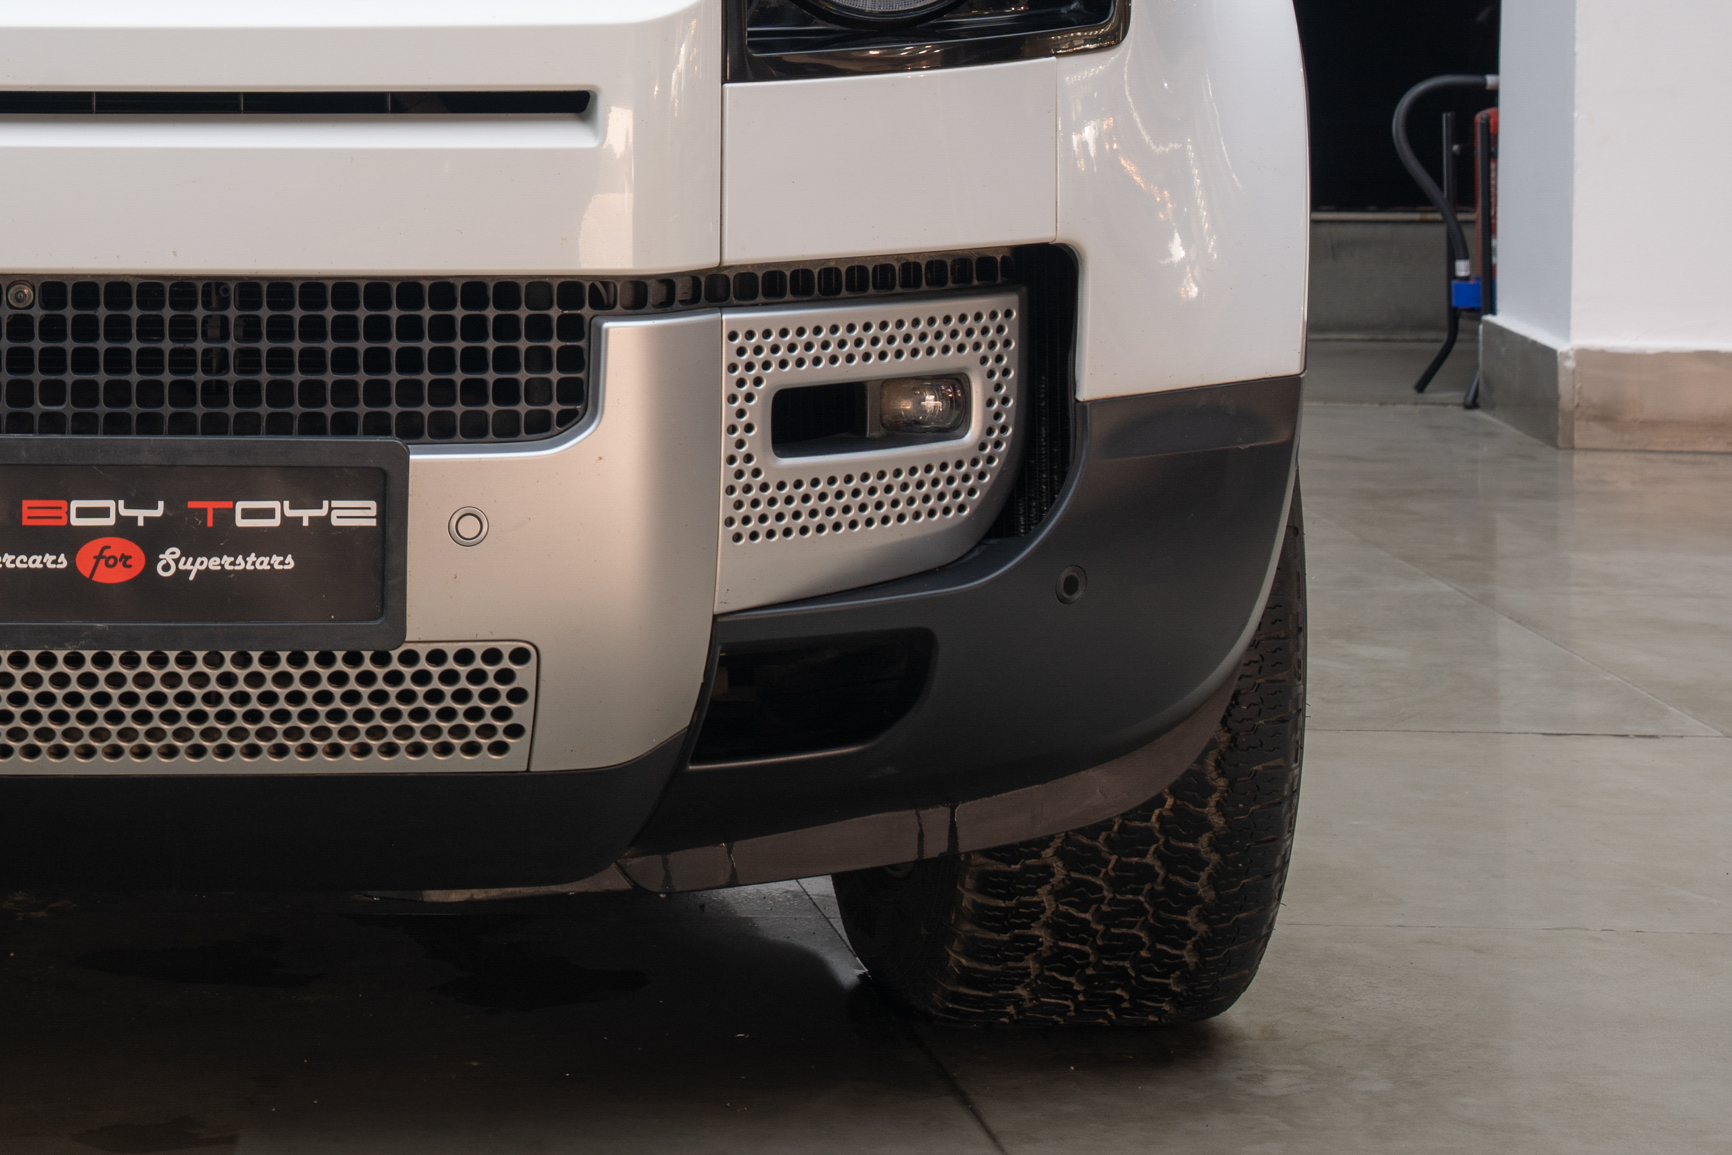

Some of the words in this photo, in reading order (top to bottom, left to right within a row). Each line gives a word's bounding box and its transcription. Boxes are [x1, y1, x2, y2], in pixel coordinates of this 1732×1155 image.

[21, 499, 164, 527] BOY
[187, 500, 377, 528] TOYZ
[88, 545, 133, 580] for
[156, 546, 295, 581] Superstars
